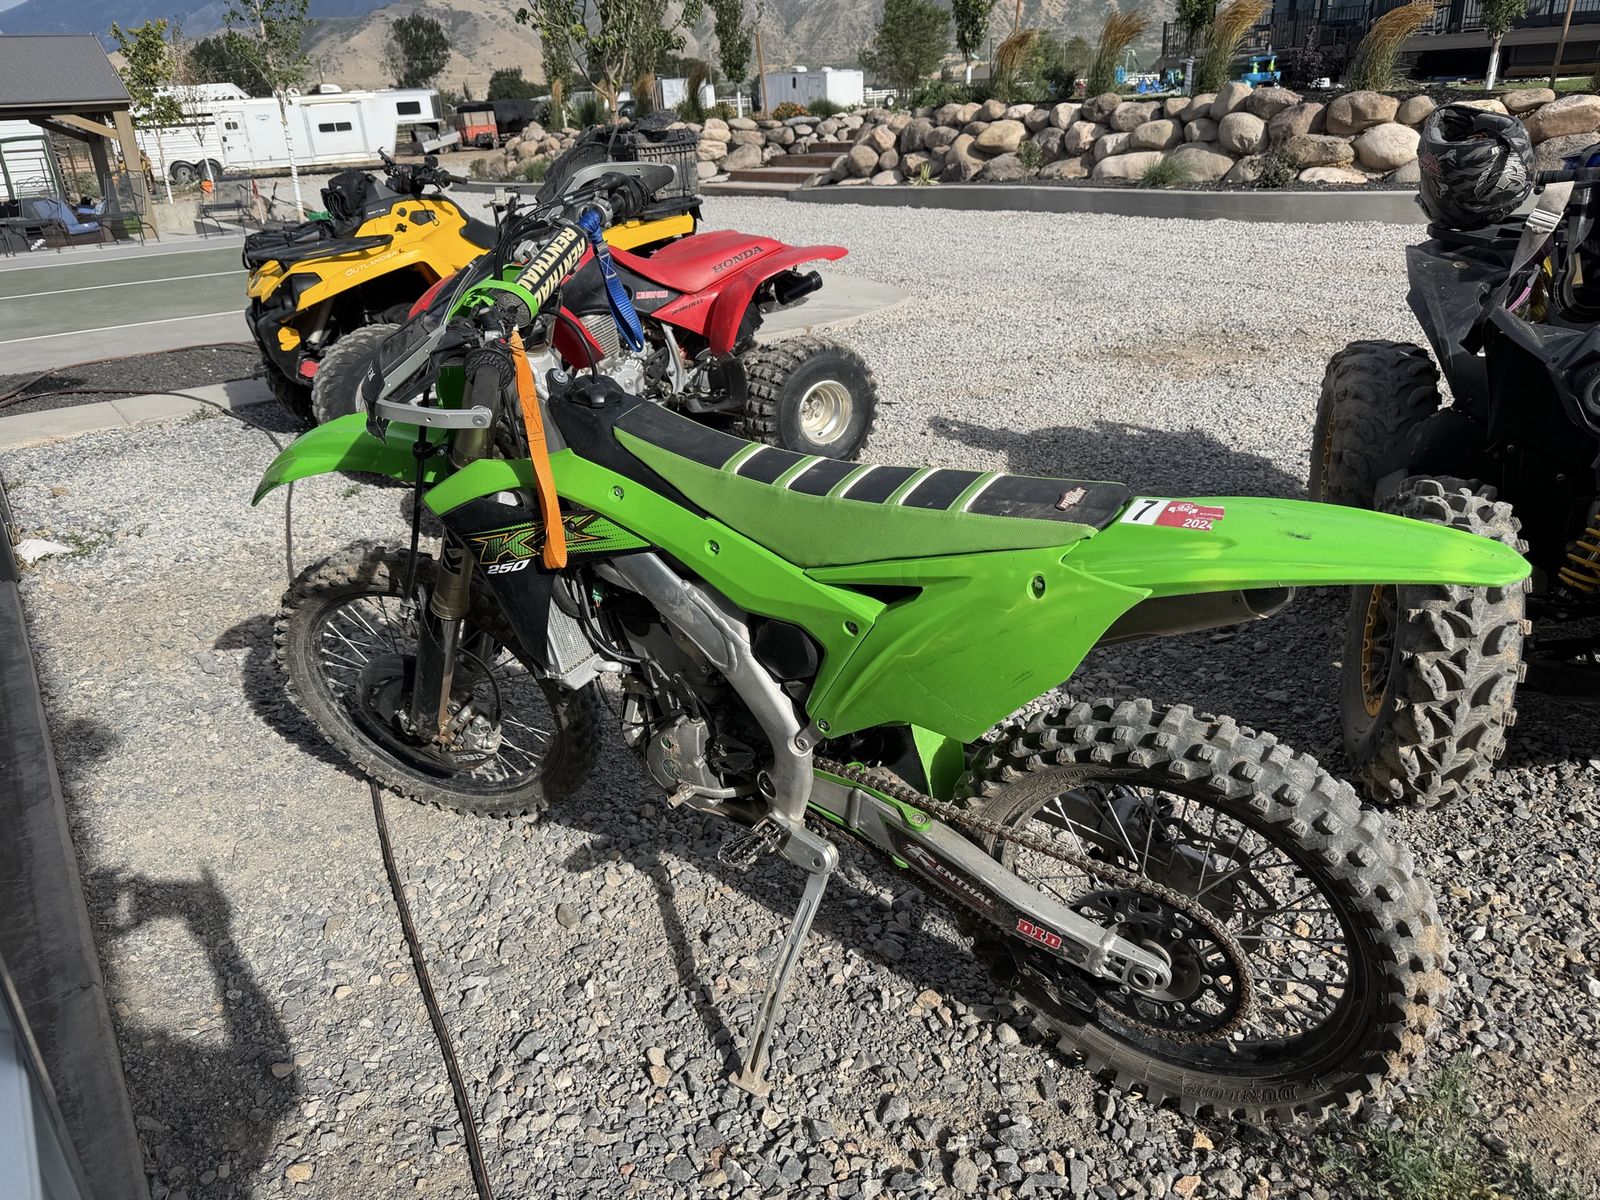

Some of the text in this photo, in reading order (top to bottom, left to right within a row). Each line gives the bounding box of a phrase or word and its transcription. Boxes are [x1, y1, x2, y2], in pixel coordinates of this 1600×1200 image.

[345, 251, 399, 277] OUTLANDER
[517, 227, 578, 291] RENTHAL
[712, 245, 764, 273] HONDA
[1133, 500, 1159, 521] 7
[487, 559, 531, 575] 250
